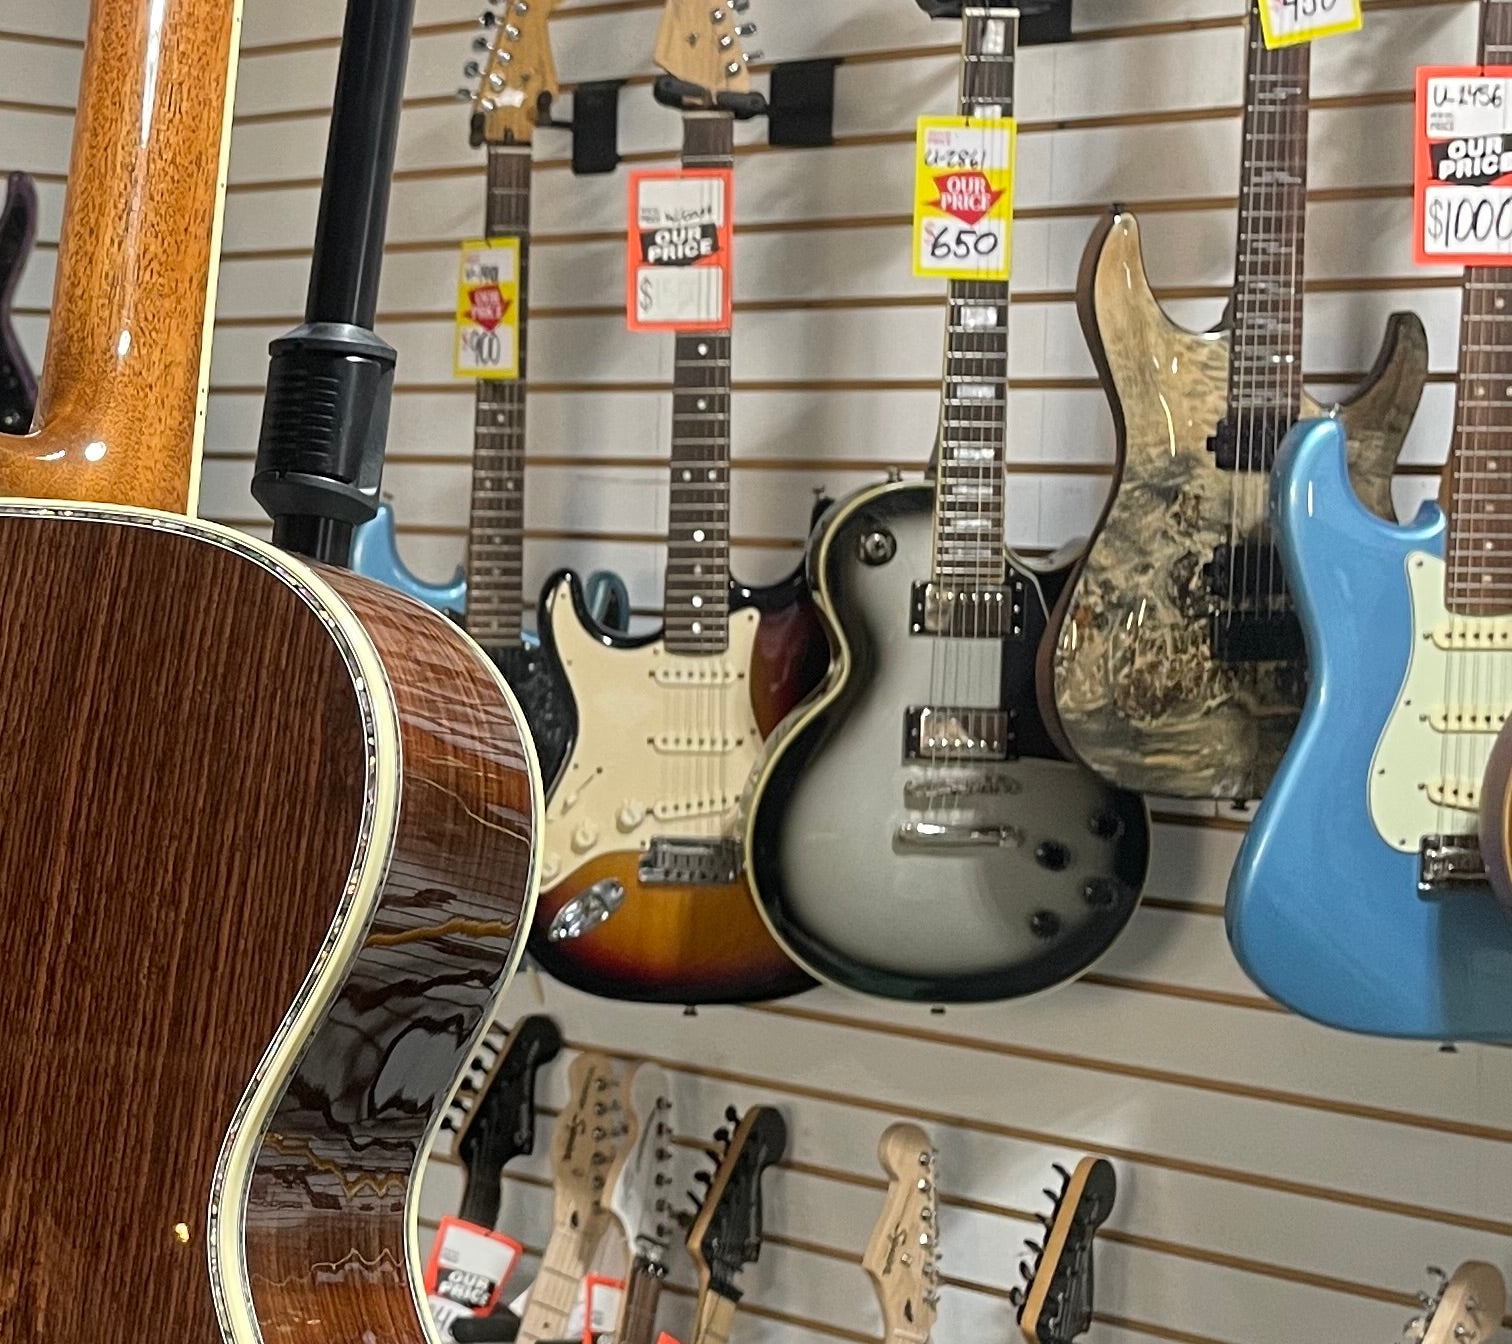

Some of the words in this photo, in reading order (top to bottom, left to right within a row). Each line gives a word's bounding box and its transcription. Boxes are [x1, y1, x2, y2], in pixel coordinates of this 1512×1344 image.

[1447, 136, 1503, 160] OUR
[946, 175, 986, 193] OUR
[941, 191, 991, 212] PRICE
[1427, 198, 1512, 248] $1000
[654, 225, 703, 246] OUR
[647, 238, 714, 264] PRICE
[447, 1270, 491, 1289] OUR
[438, 1279, 492, 1307] PRICE
